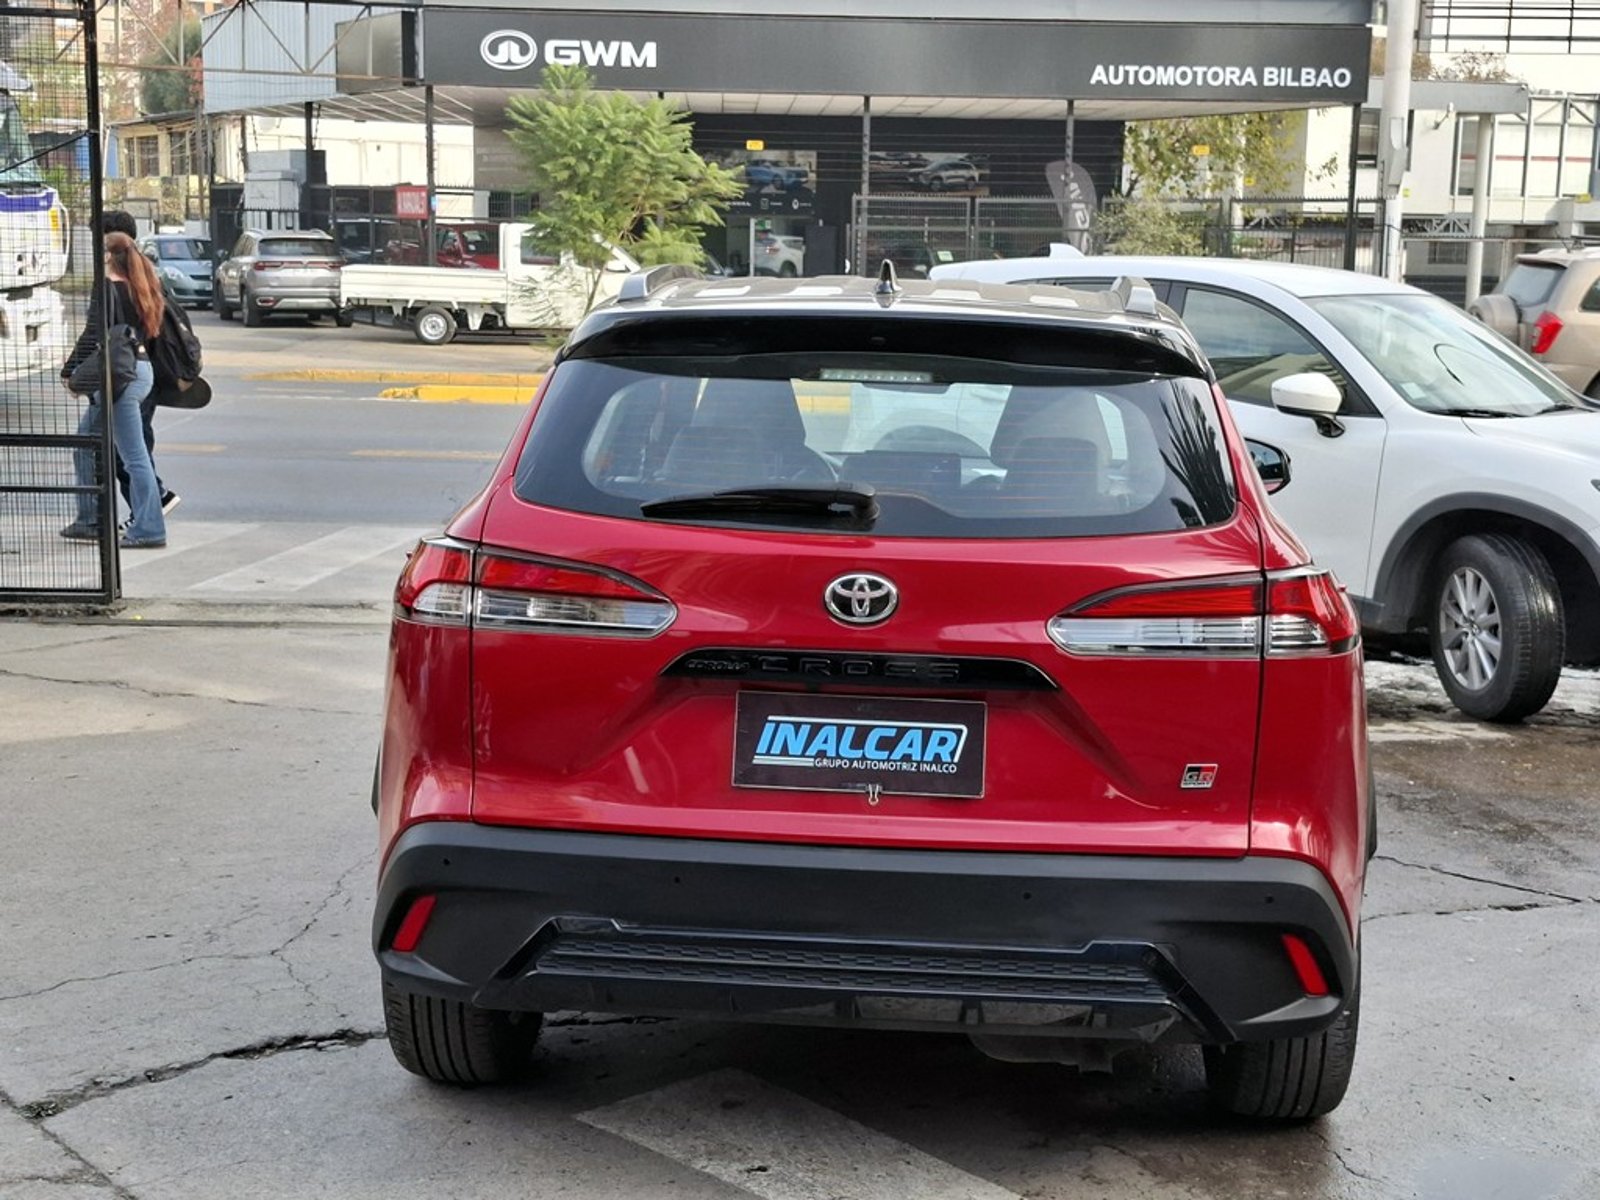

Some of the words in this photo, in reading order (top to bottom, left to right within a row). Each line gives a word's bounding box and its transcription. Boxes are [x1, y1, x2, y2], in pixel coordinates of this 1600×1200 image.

[544, 39, 657, 68] GWM
[1090, 64, 1258, 87] AUTOMOTORA
[1262, 66, 1352, 89] BILBAO
[758, 655, 961, 679] CROSS
[756, 722, 958, 763] INALCAR
[815, 757, 849, 769] GRUPO
[851, 761, 917, 772] AUTOMOTRIZ
[919, 763, 957, 774] INALCO
